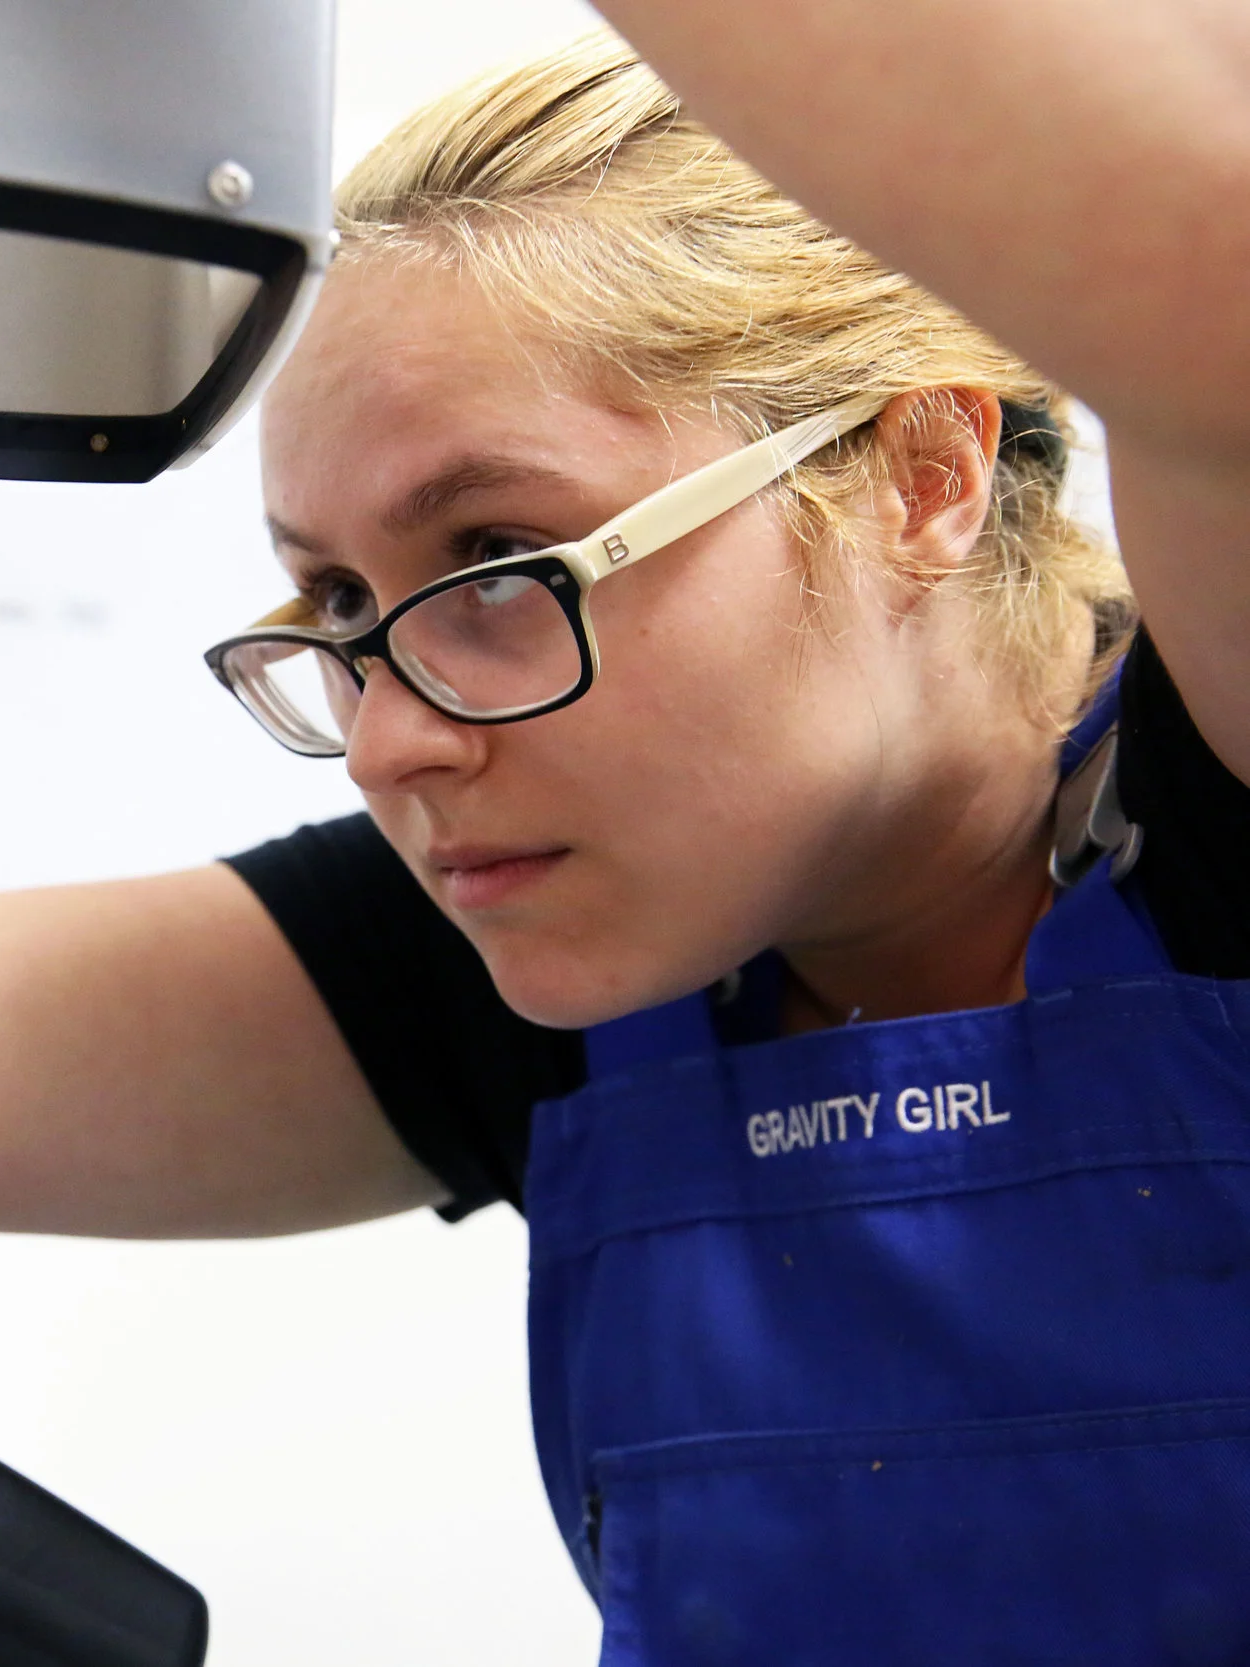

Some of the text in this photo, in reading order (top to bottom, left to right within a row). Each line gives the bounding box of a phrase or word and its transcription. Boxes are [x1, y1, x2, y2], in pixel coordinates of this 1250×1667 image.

[602, 533, 630, 564] B
[747, 1080, 1011, 1158] GRAVITY GIRL
